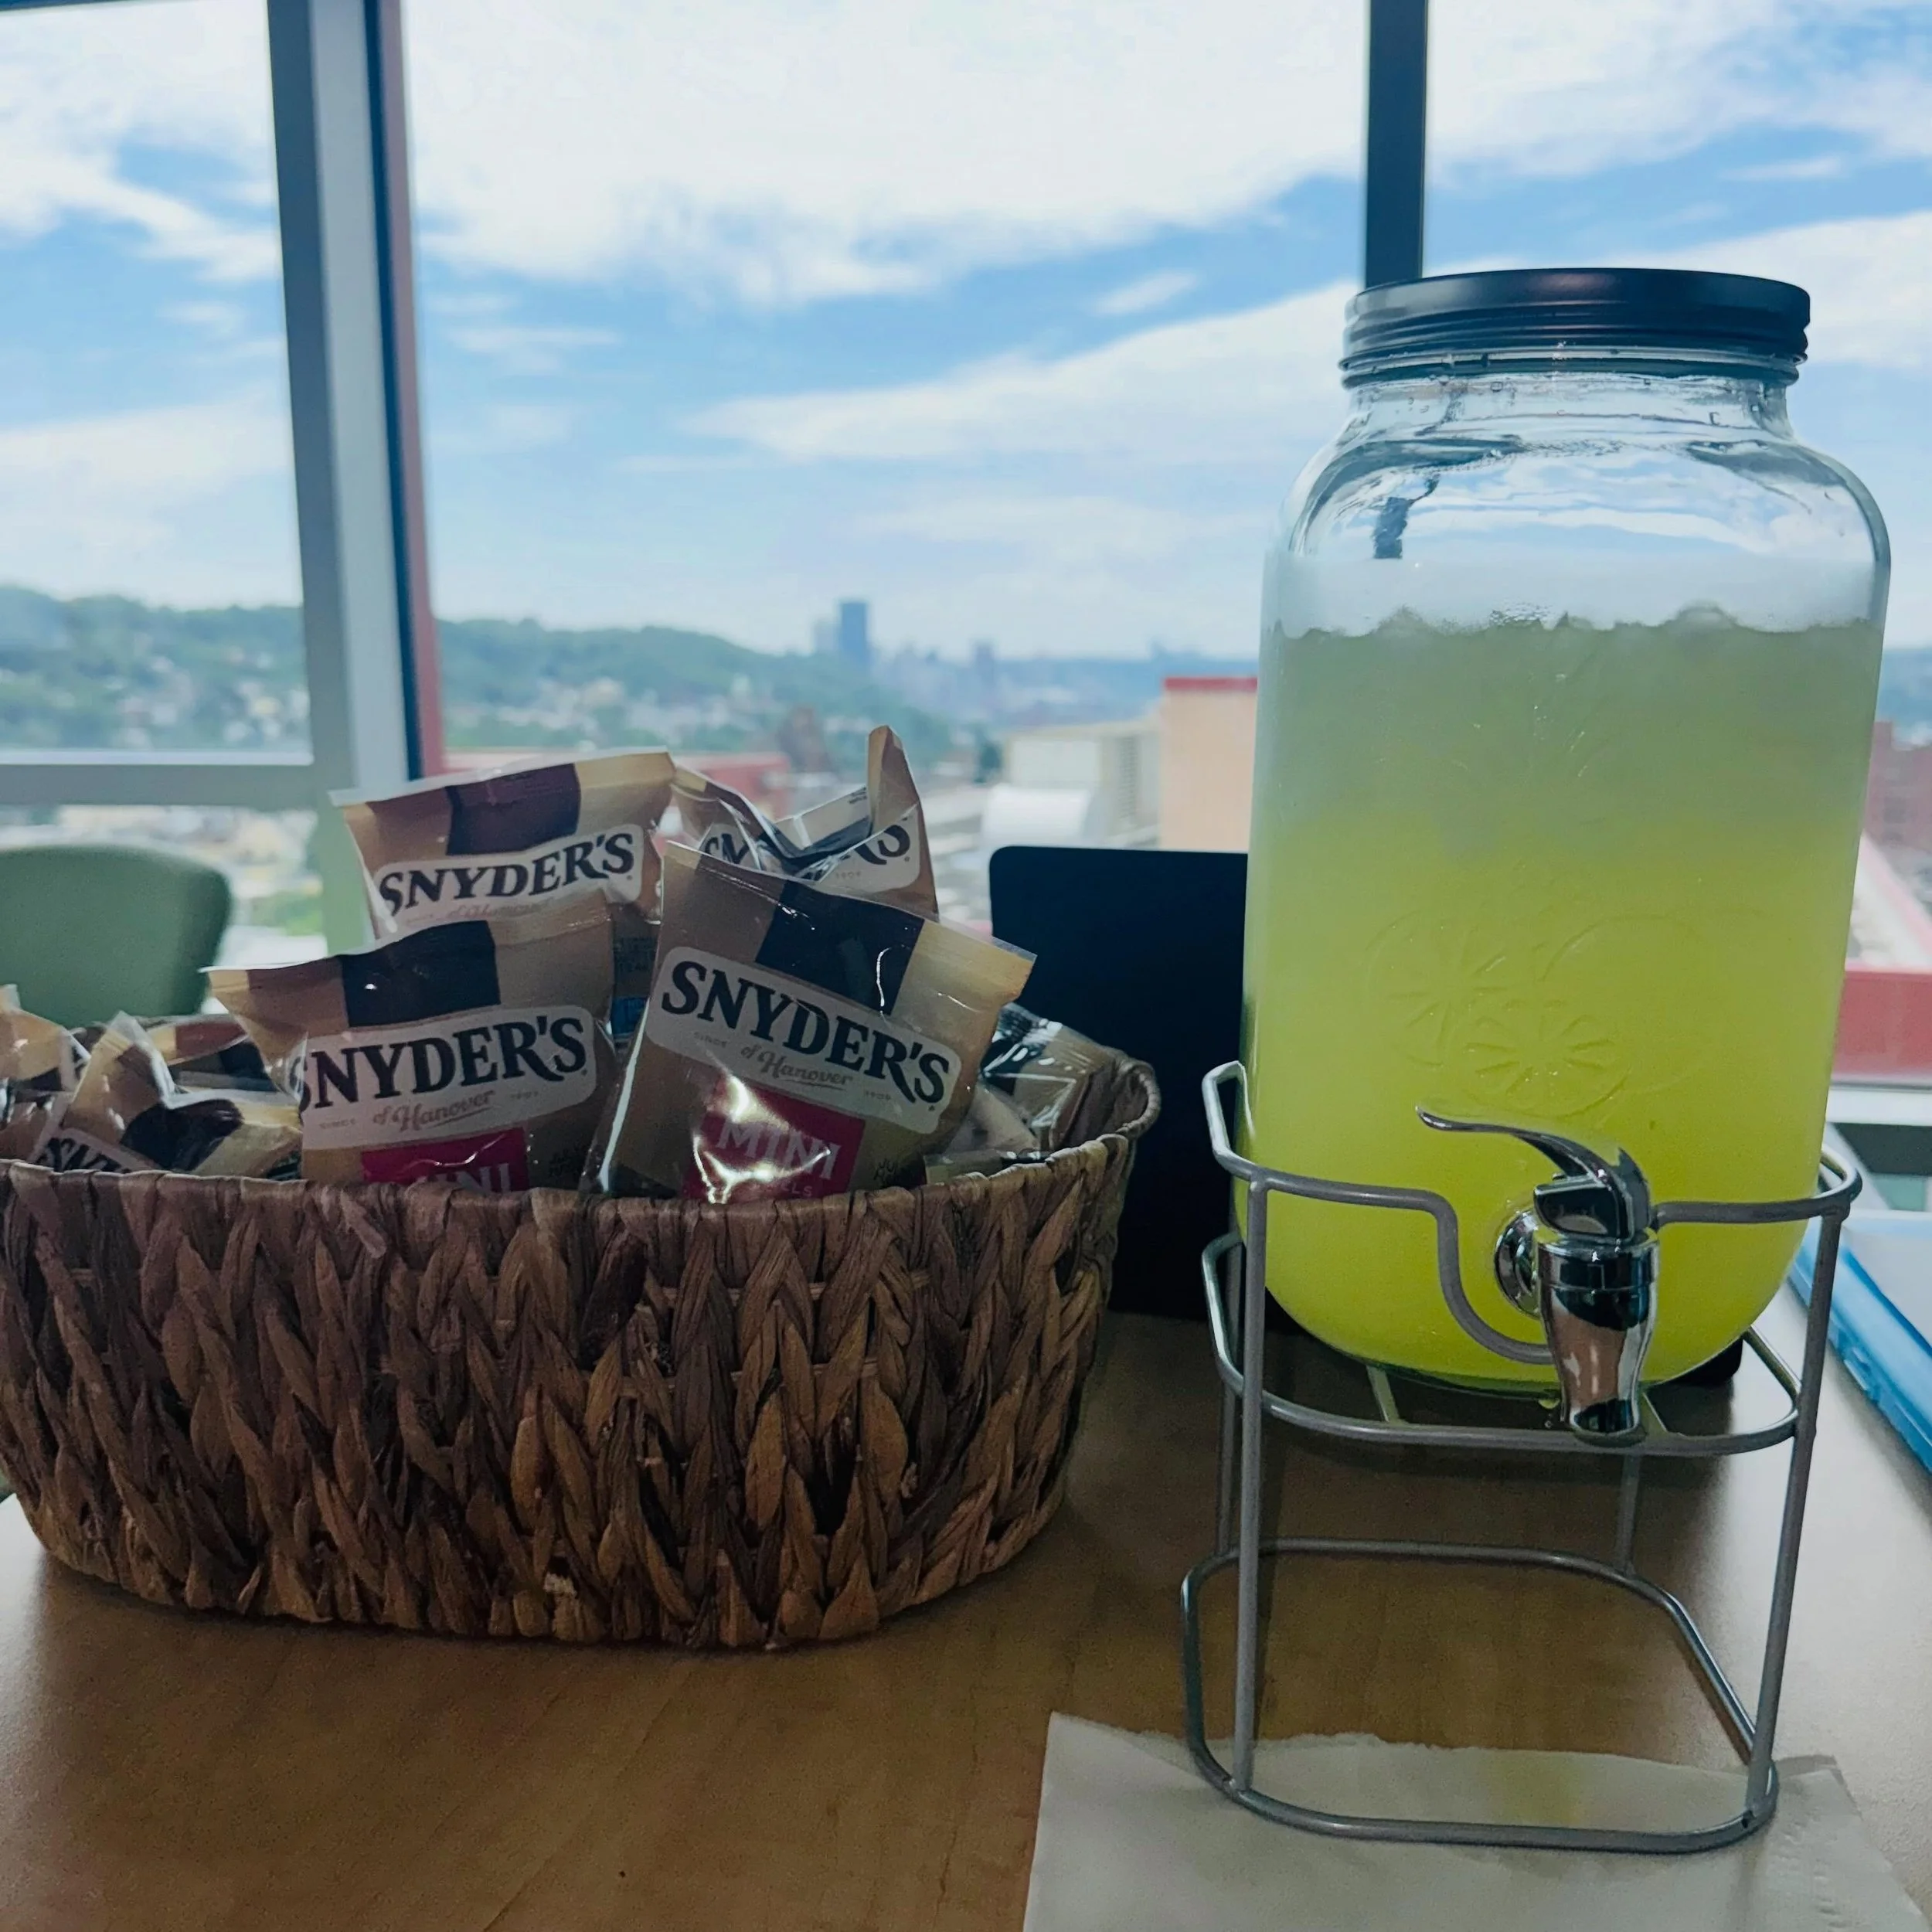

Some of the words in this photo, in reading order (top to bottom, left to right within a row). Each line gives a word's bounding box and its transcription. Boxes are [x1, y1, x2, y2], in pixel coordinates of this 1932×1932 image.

[379, 832, 635, 917] SNYDER'S
[662, 961, 950, 1104] SNYDER'S
[760, 1050, 853, 1086] Hanover
[392, 1090, 495, 1131] Hanover
[716, 1118, 842, 1180] MINI
